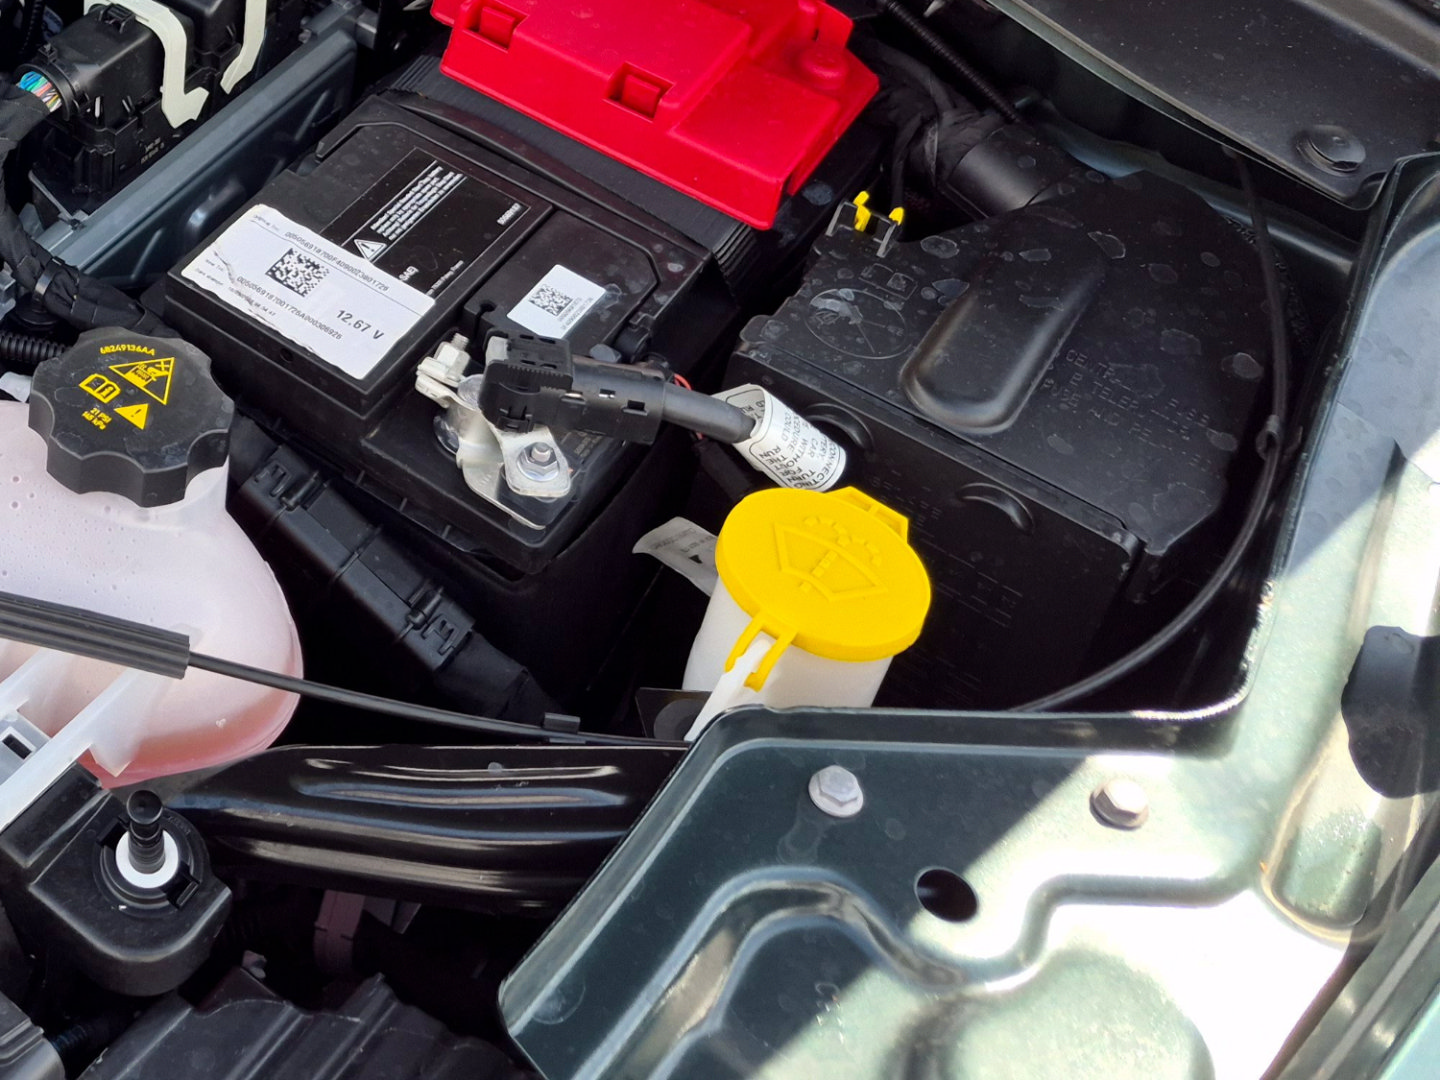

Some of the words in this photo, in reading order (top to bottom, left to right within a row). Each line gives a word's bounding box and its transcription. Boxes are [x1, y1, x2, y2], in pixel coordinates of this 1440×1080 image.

[336, 308, 372, 334] 12.67
[373, 328, 386, 341] V
[759, 445, 781, 459] RUN
